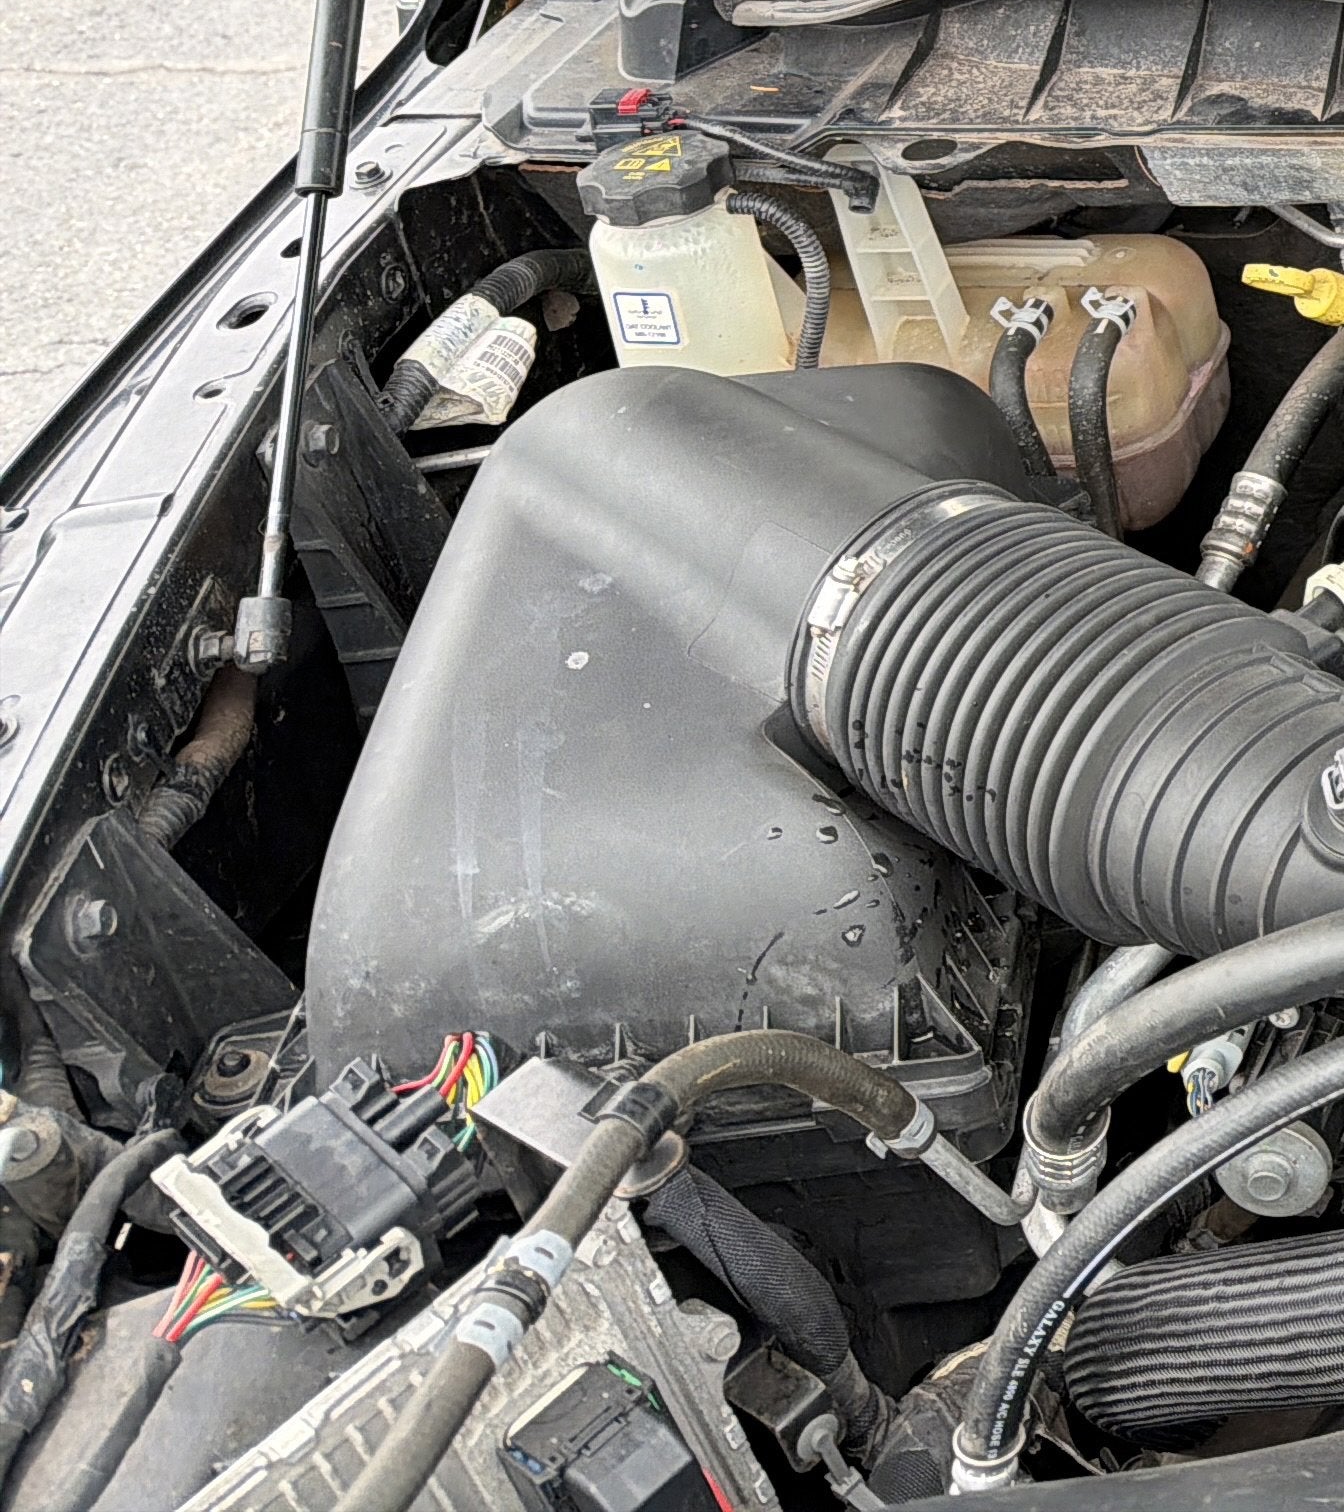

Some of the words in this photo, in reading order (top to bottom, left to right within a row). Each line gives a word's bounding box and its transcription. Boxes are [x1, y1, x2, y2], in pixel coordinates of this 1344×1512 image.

[1024, 1300, 1066, 1358] GALAXY
[1010, 1358, 1028, 1378] SLE
[996, 1403, 1008, 1419] A/C
[987, 1420, 1004, 1447] HOSE
